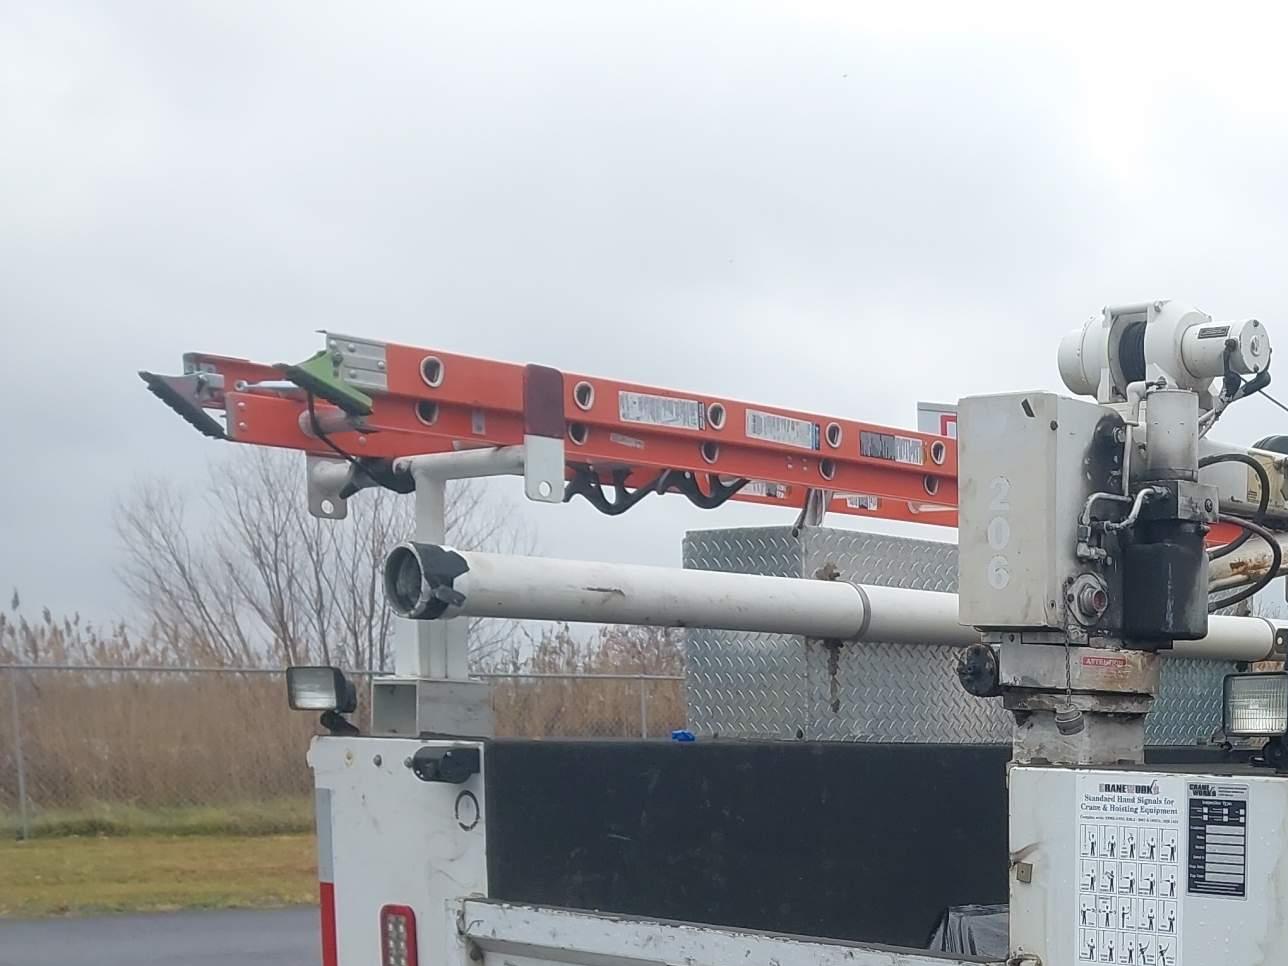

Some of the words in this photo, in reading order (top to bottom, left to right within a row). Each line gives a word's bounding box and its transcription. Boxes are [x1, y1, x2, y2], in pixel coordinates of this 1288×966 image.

[1084, 793, 1116, 804] Standard
[1117, 795, 1136, 805] Hand
[1137, 797, 1162, 807] Signals
[1109, 804, 1139, 815] Hoisting
[1140, 805, 1178, 816] Equipment
